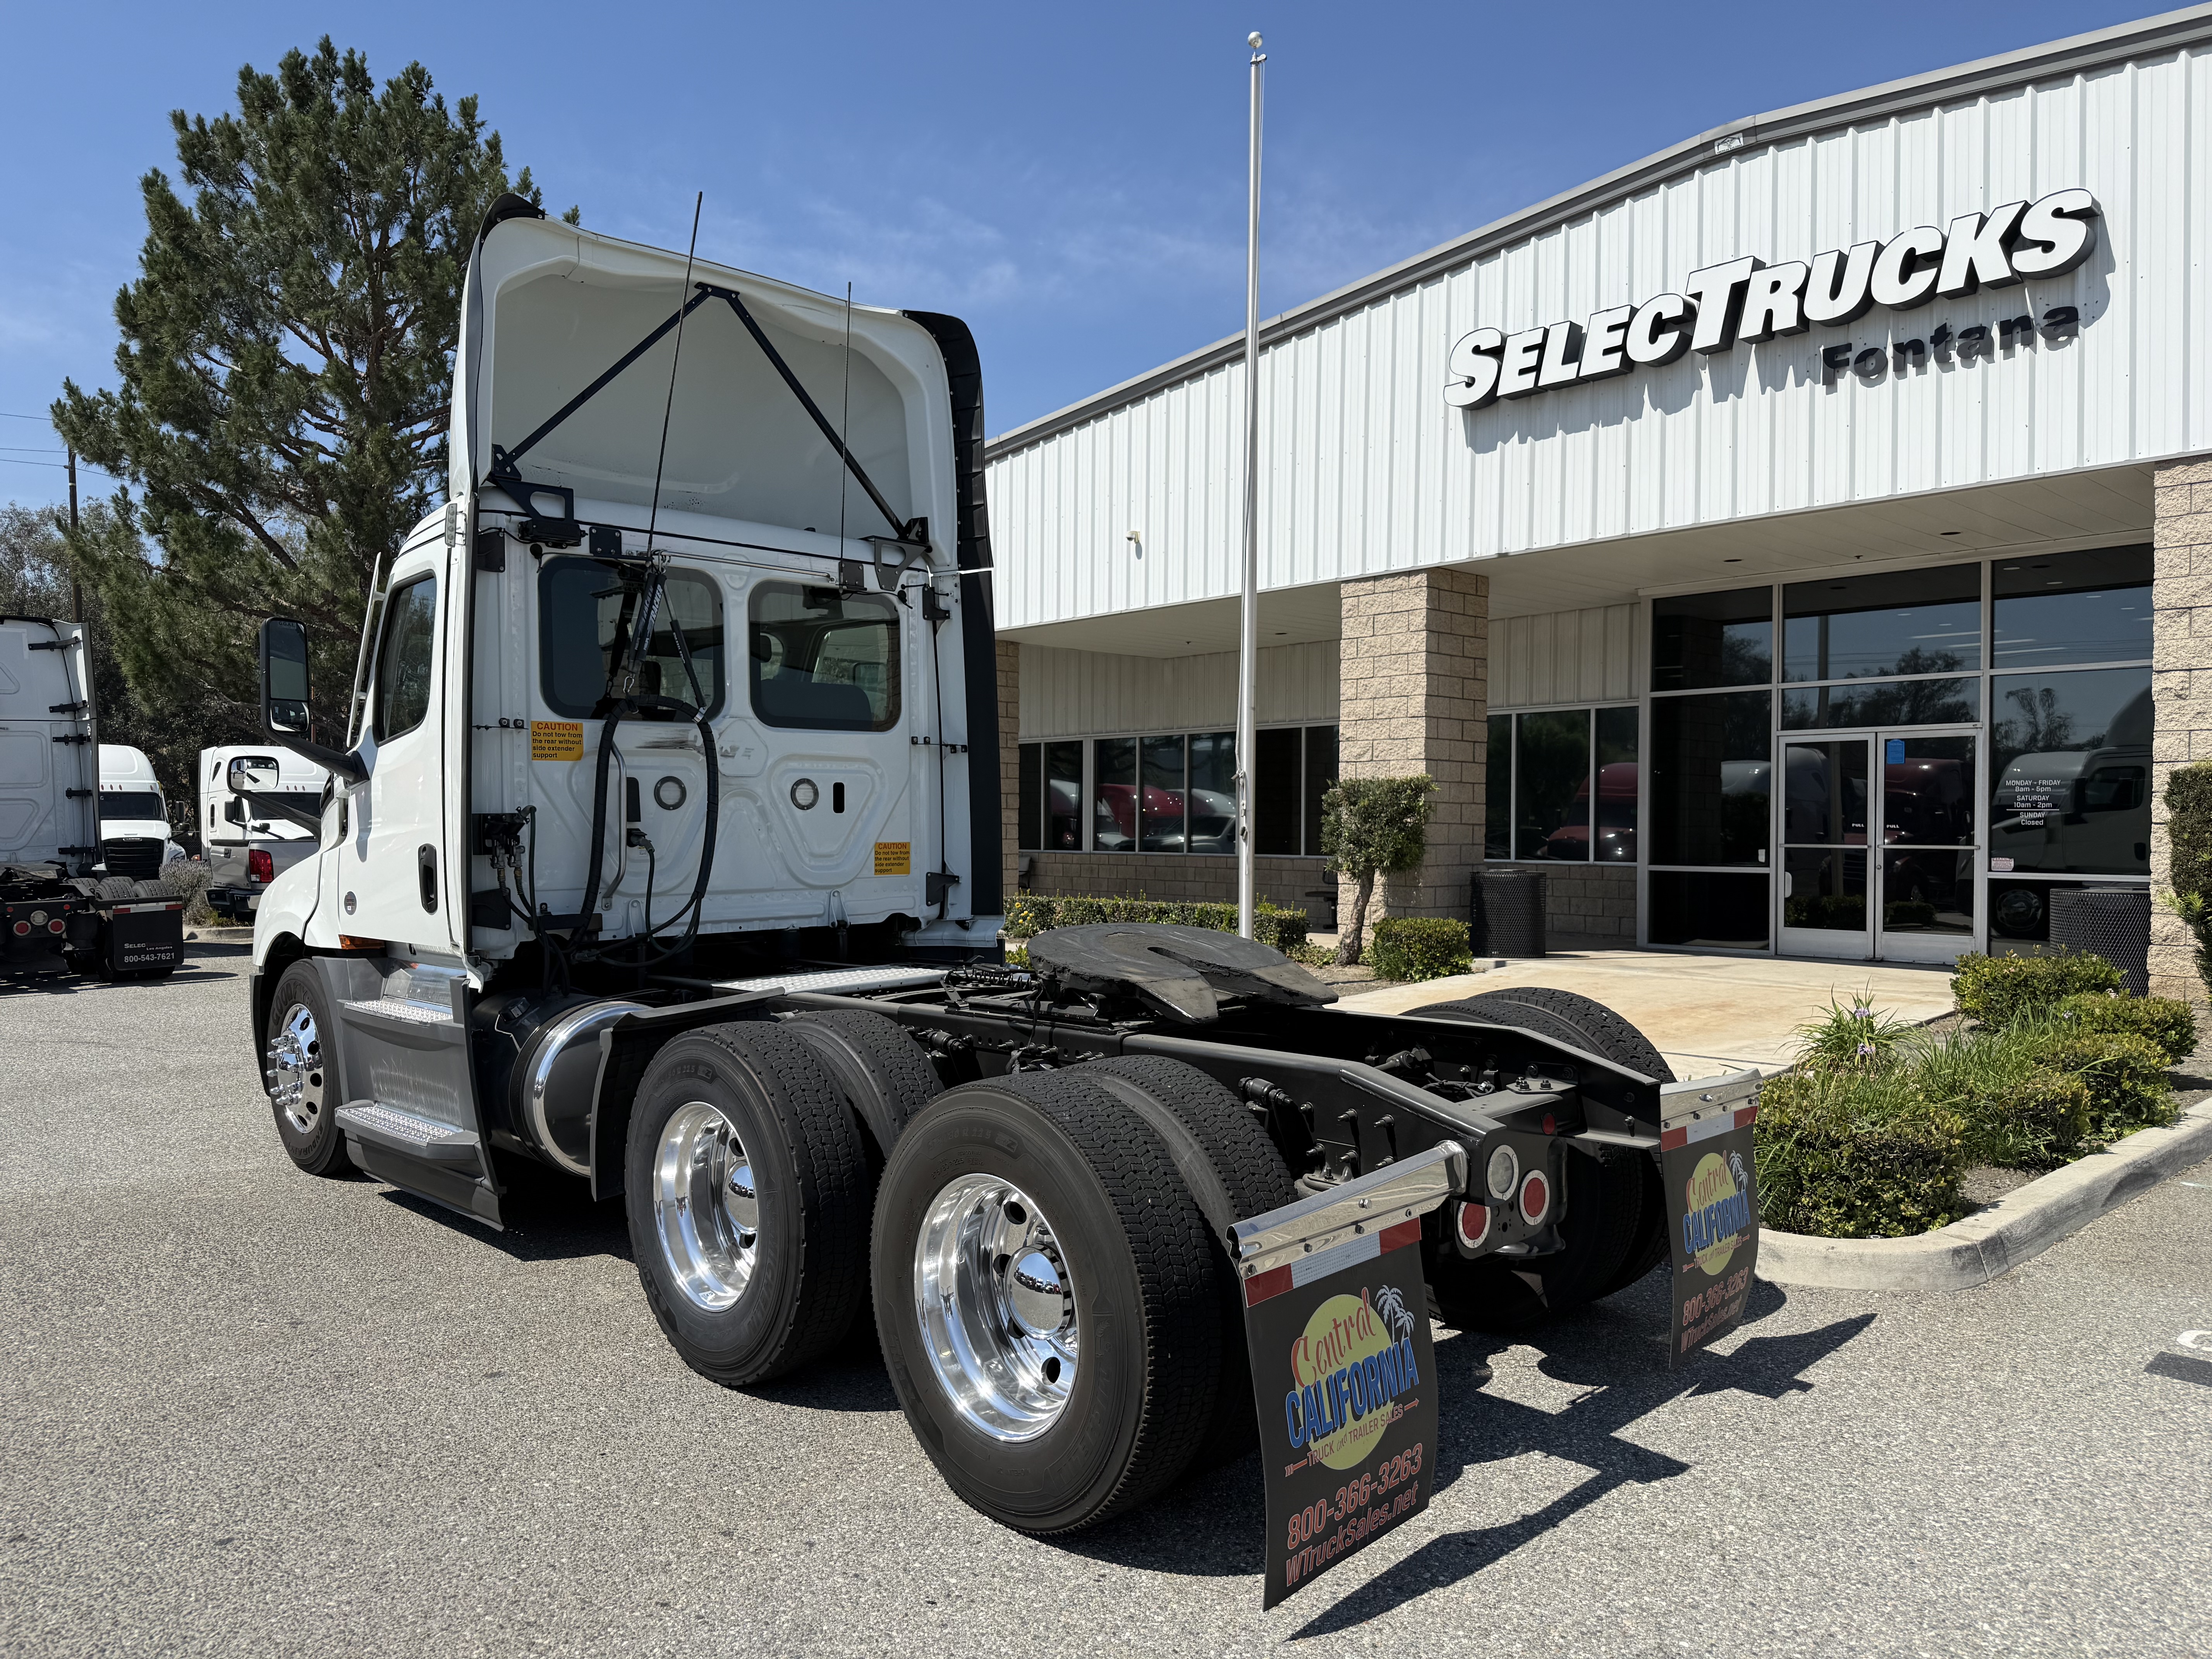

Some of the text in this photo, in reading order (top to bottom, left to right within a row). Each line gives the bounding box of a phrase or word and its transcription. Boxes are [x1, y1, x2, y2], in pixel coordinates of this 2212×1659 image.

[1444, 187, 2100, 410] SELECTRUCKS
[1822, 305, 2080, 386] Fontana
[649, 584, 663, 623] TRACKER
[537, 722, 578, 731] CAUTION
[124, 953, 174, 963] 800-543-7621
[1686, 1150, 1729, 1213] Central
[1683, 1189, 1750, 1254] CALIFORNIA
[1694, 1253, 1708, 1269] TRUCK
[1715, 1242, 1730, 1258] TRAILER
[1683, 1266, 1749, 1326] 800-366-3263
[1291, 1286, 1376, 1388] Central
[1285, 1337, 1419, 1448] CALIFORNIA
[1307, 1404, 1403, 1467] TRUCK and TRAILER SALES
[1287, 1443, 1422, 1549] 800-366-3263
[1286, 1480, 1419, 1587] WTruckSales.net
